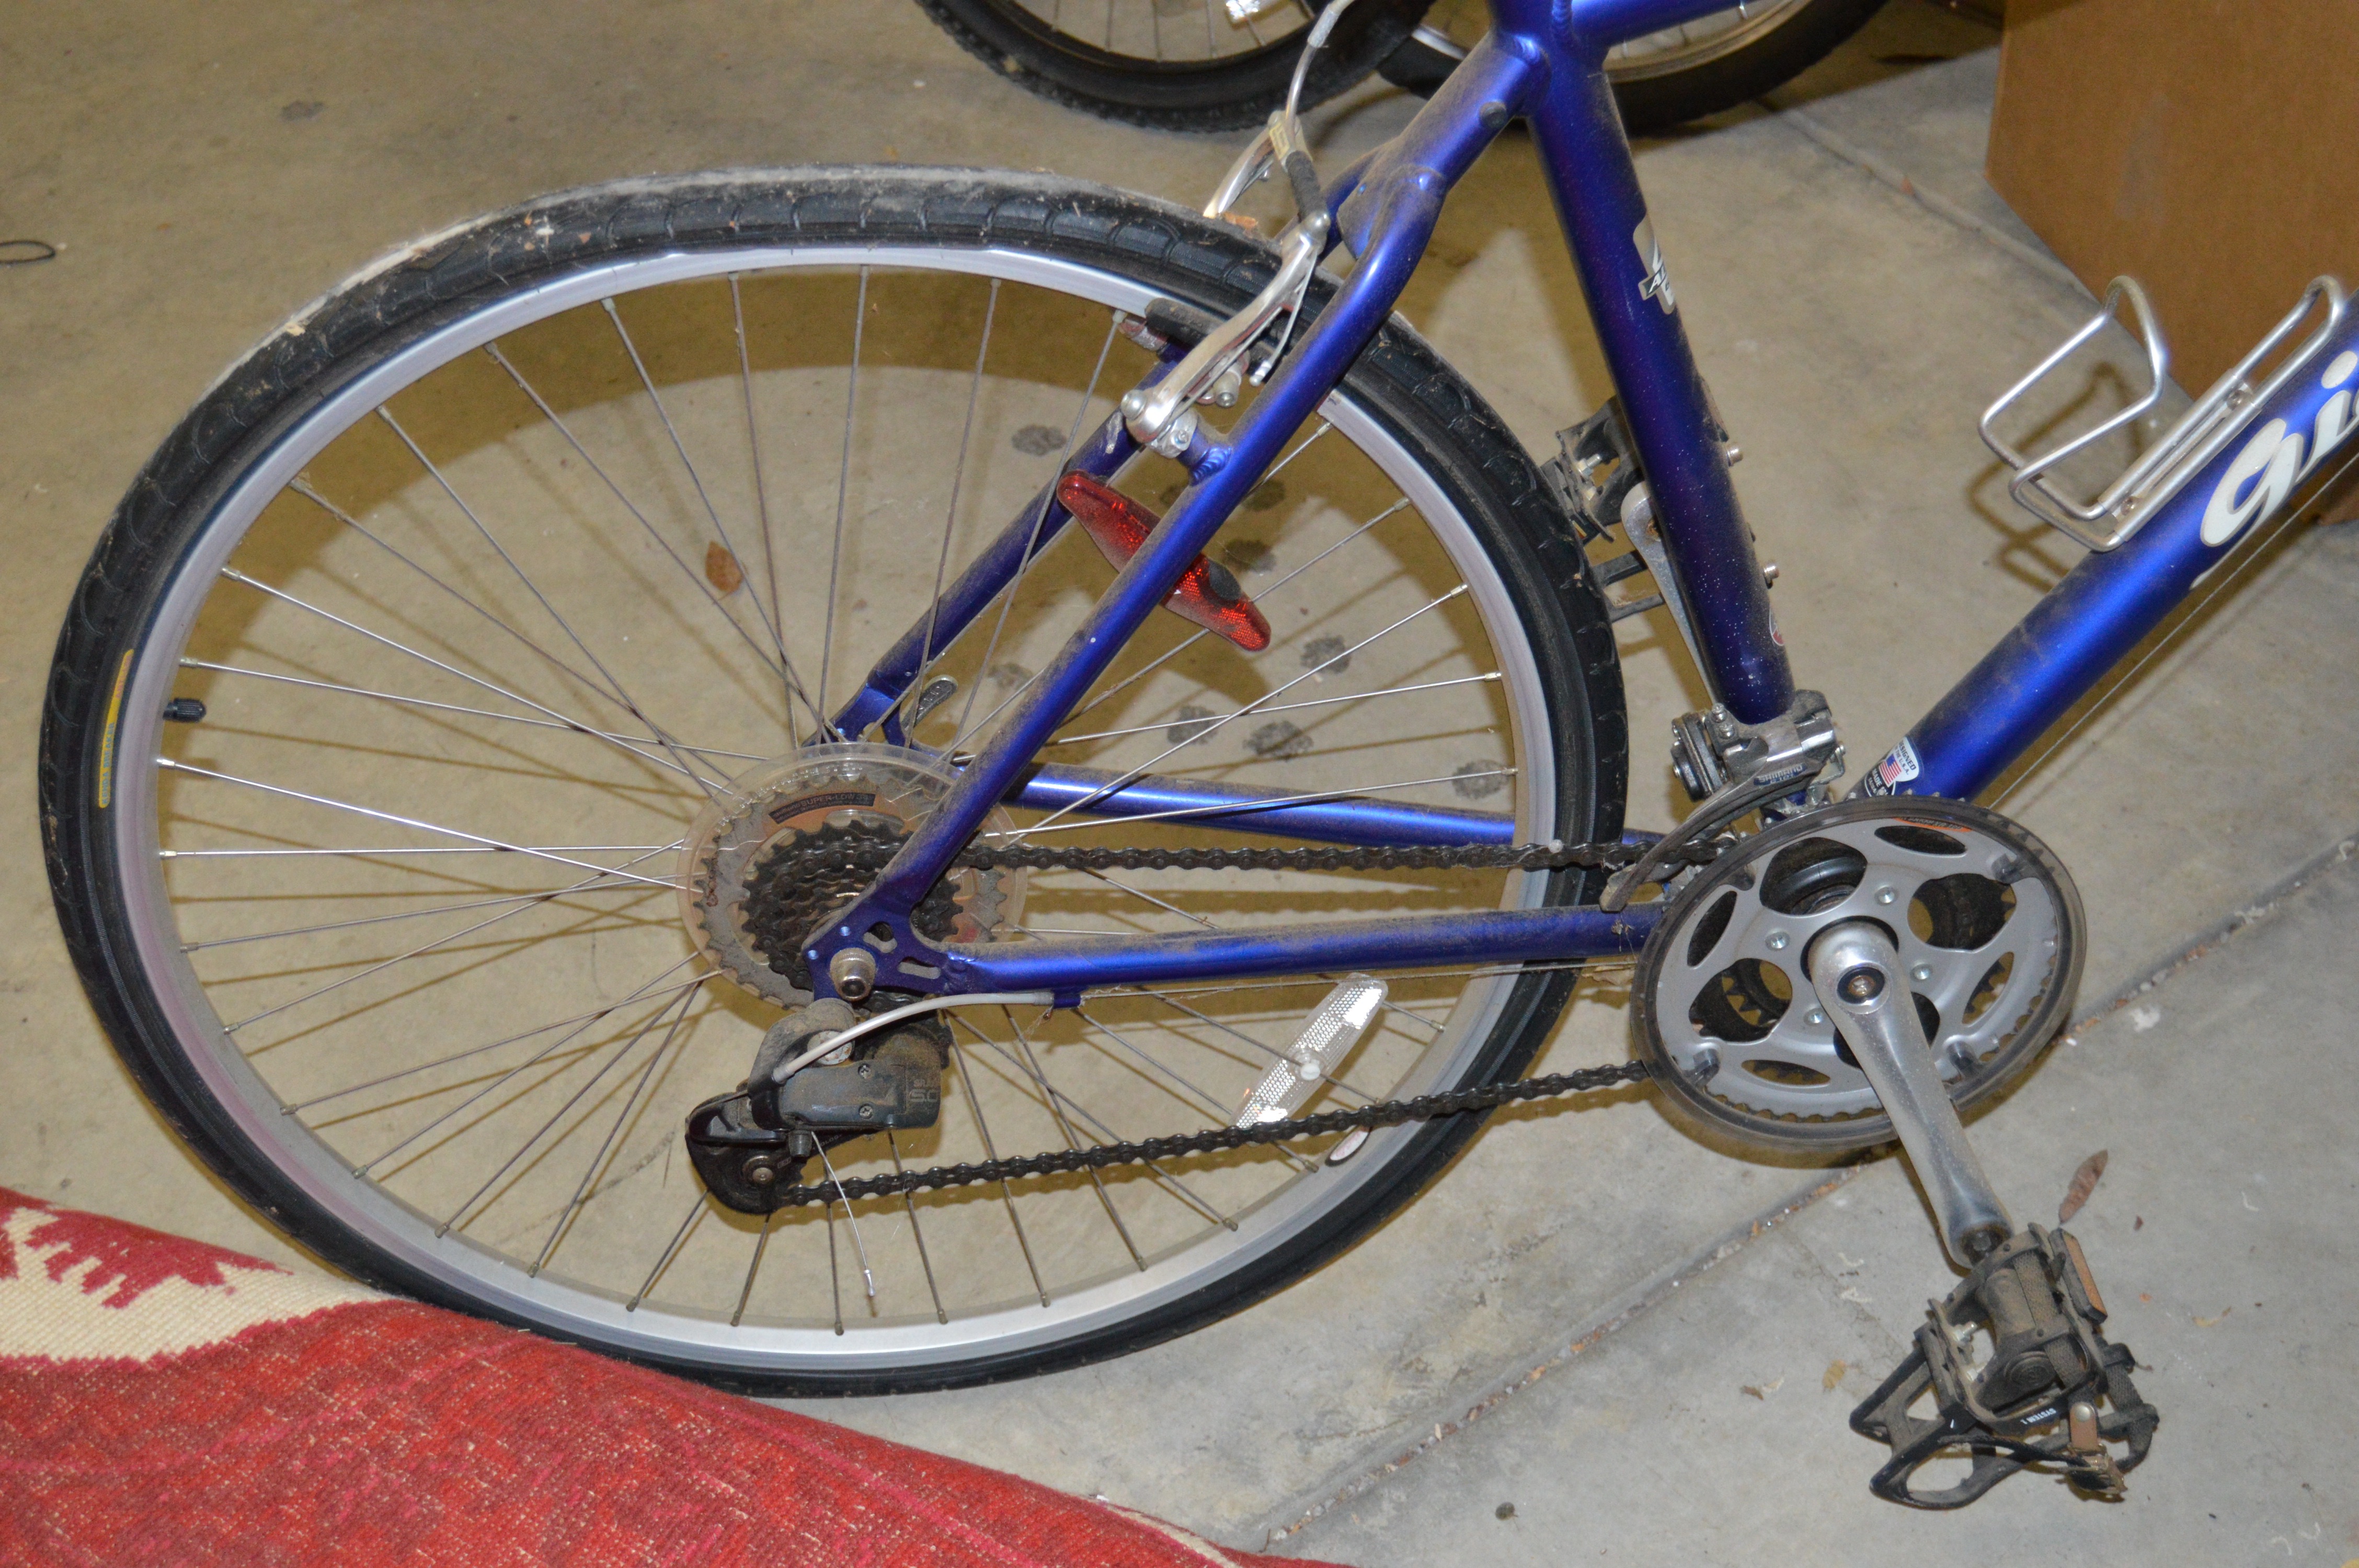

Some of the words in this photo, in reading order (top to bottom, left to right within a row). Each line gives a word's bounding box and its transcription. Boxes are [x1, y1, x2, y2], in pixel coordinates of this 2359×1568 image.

[2189, 350, 2359, 590] gi
[1899, 741, 1917, 771] DESIGNED
[1757, 763, 1803, 783] SHIMANO
[1899, 758, 1909, 775] U.S.A.
[1872, 768, 1882, 787] MADE
